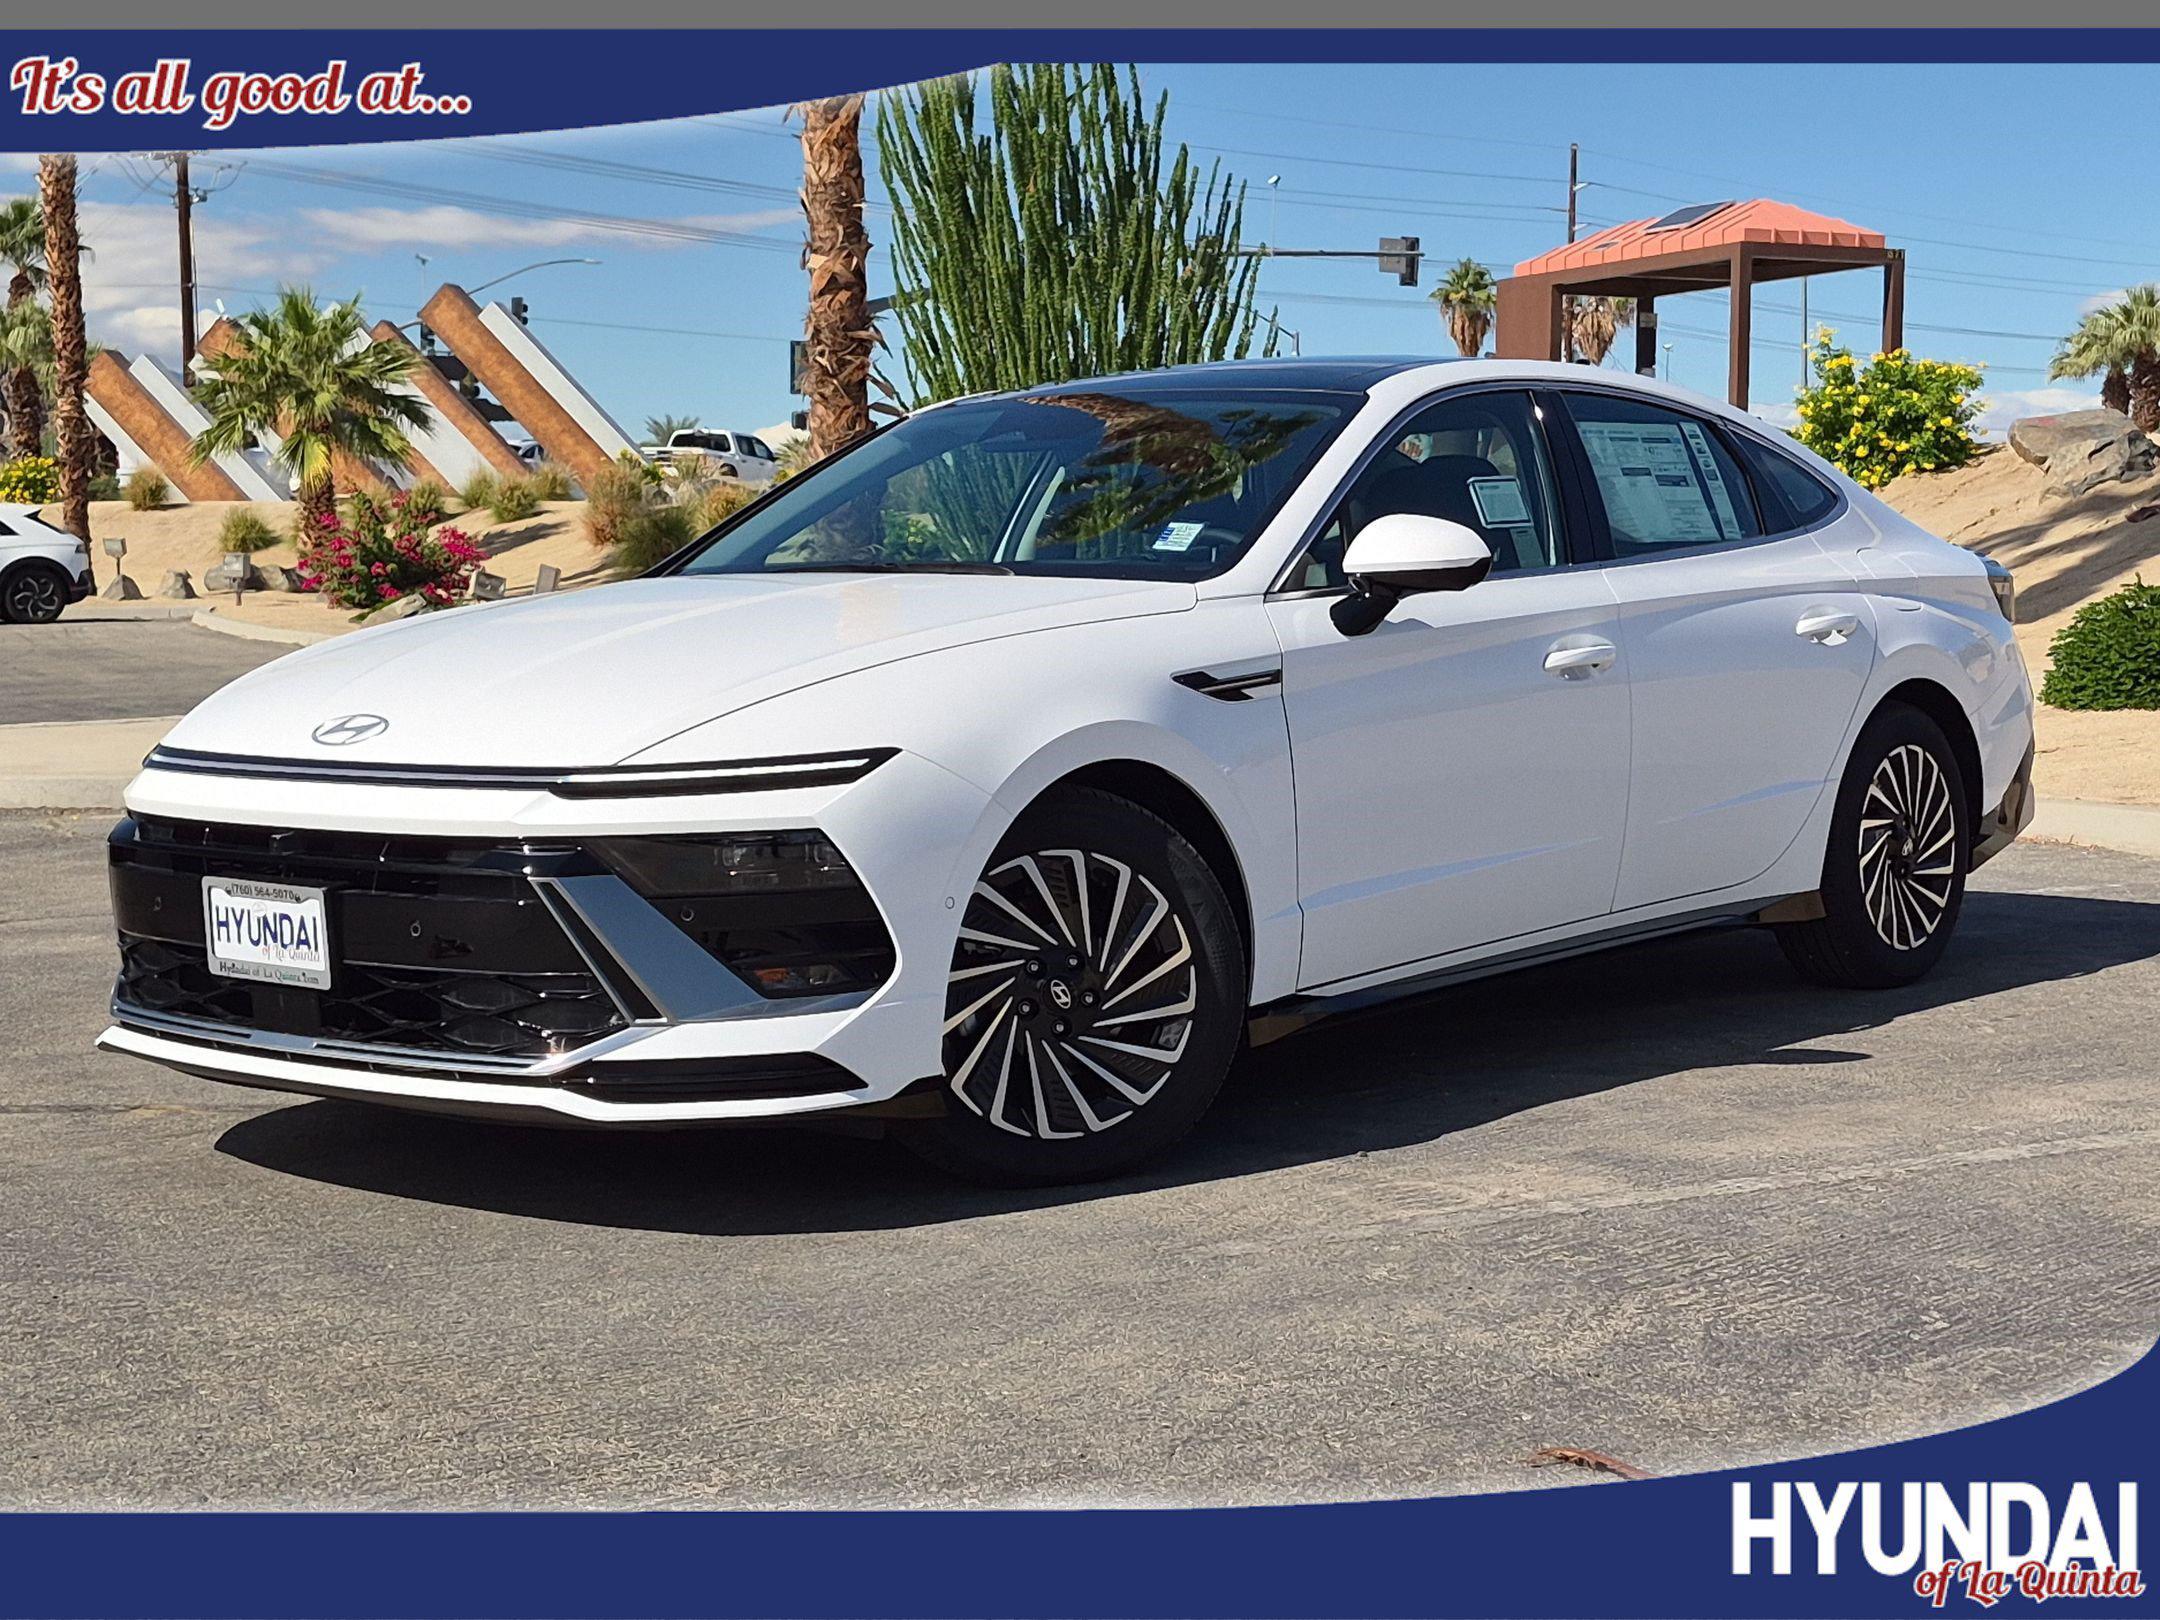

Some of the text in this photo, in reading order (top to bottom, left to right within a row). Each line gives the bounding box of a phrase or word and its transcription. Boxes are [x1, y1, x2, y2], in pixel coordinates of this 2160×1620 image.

[231, 883, 253, 896] (760)
[215, 905, 319, 953] HYUNDAI
[262, 945, 271, 960] of
